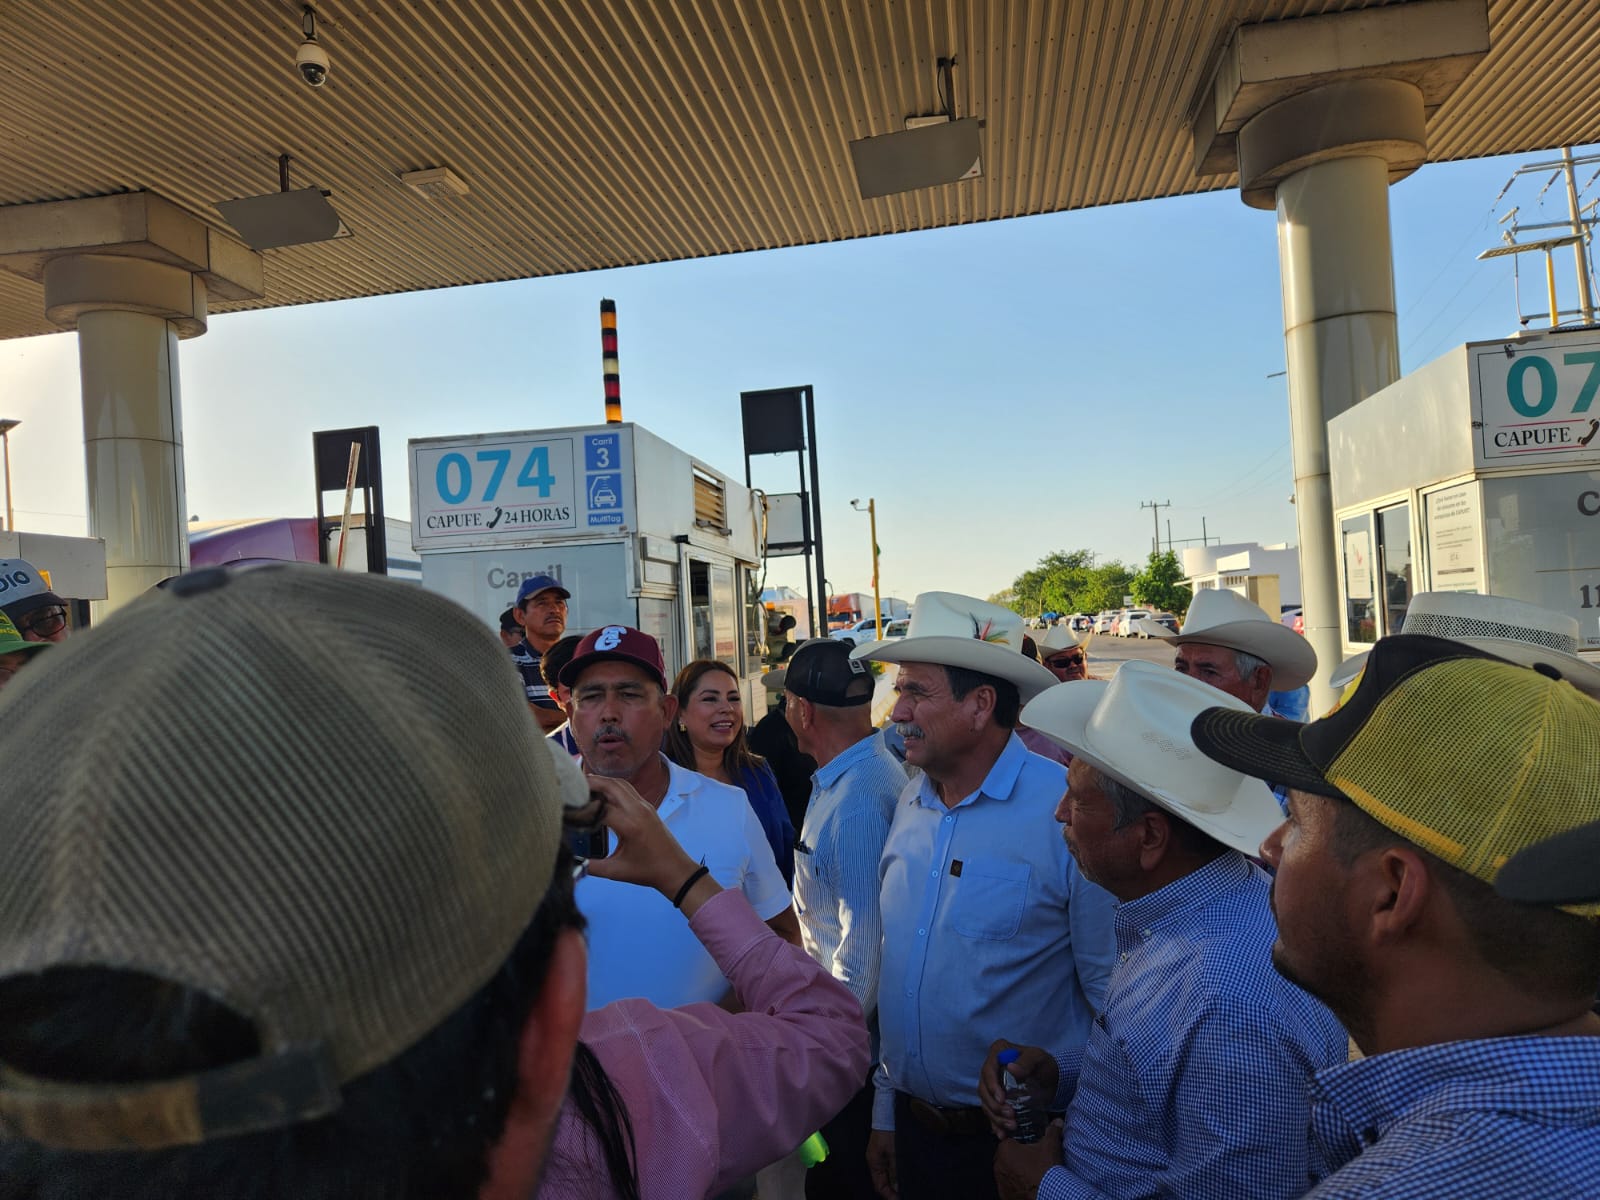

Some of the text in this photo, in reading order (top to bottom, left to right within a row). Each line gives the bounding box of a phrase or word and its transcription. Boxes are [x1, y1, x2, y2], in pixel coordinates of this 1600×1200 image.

[1506, 350, 1600, 418] 07
[591, 436, 613, 446] Carril
[1494, 426, 1571, 448] CAPUFE
[596, 447, 610, 468] 3
[435, 446, 556, 505] 074
[426, 506, 570, 529] CAPUFE 24 HORAS
